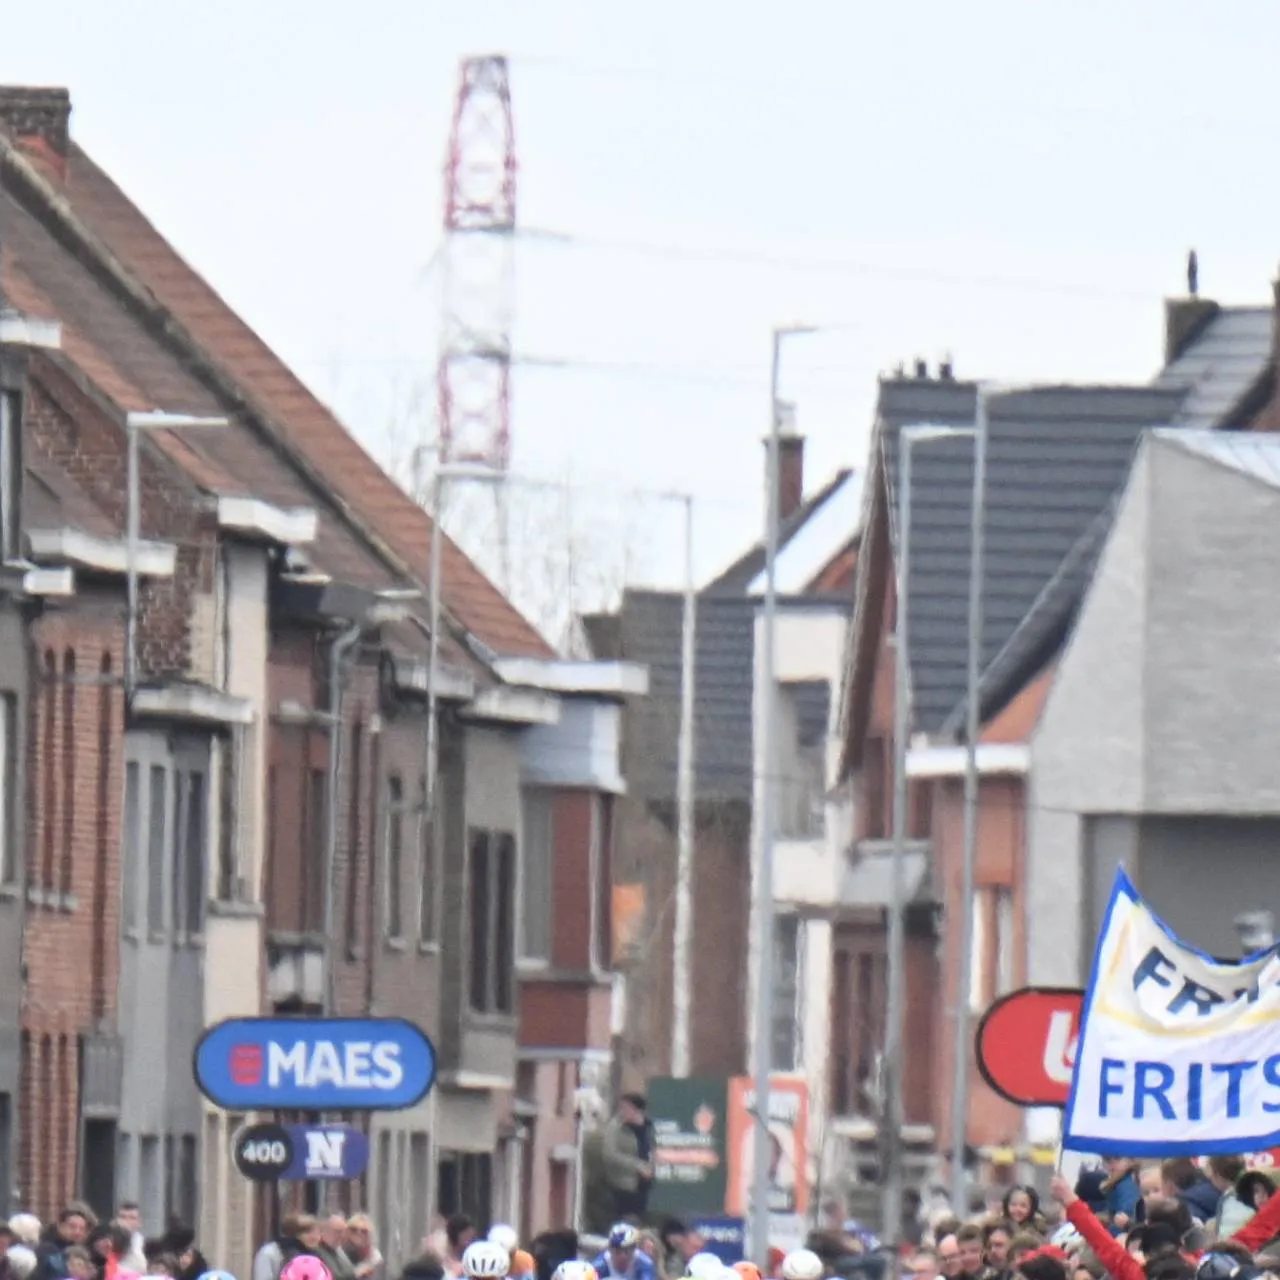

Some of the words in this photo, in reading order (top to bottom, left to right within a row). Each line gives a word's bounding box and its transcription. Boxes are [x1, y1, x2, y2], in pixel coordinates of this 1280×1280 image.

[267, 1040, 404, 1090] MAES
[241, 1140, 286, 1164] 400
[304, 1131, 345, 1169] N
